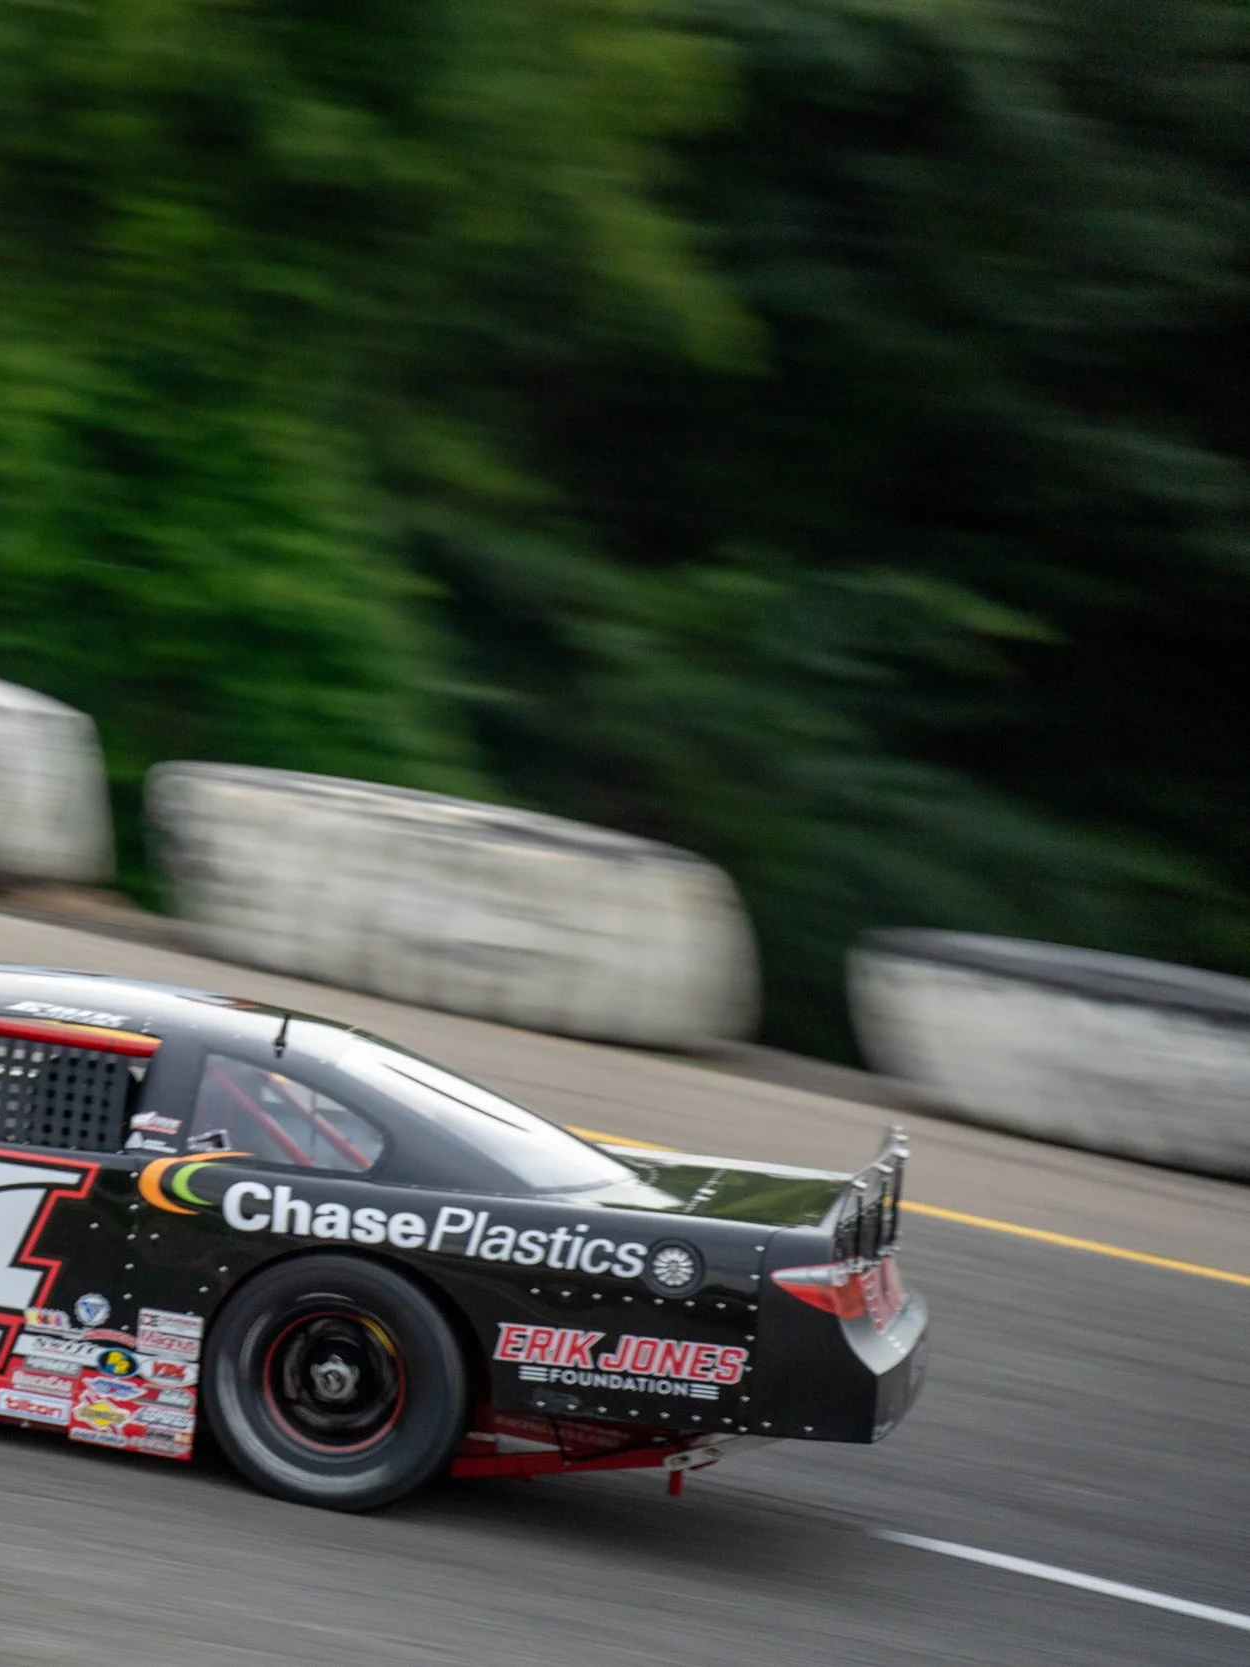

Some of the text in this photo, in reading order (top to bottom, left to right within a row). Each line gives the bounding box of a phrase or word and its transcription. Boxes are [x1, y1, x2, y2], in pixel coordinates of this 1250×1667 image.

[492, 1322, 750, 1385] ERIK JONES
[550, 1368, 690, 1397] FOUNDATION
